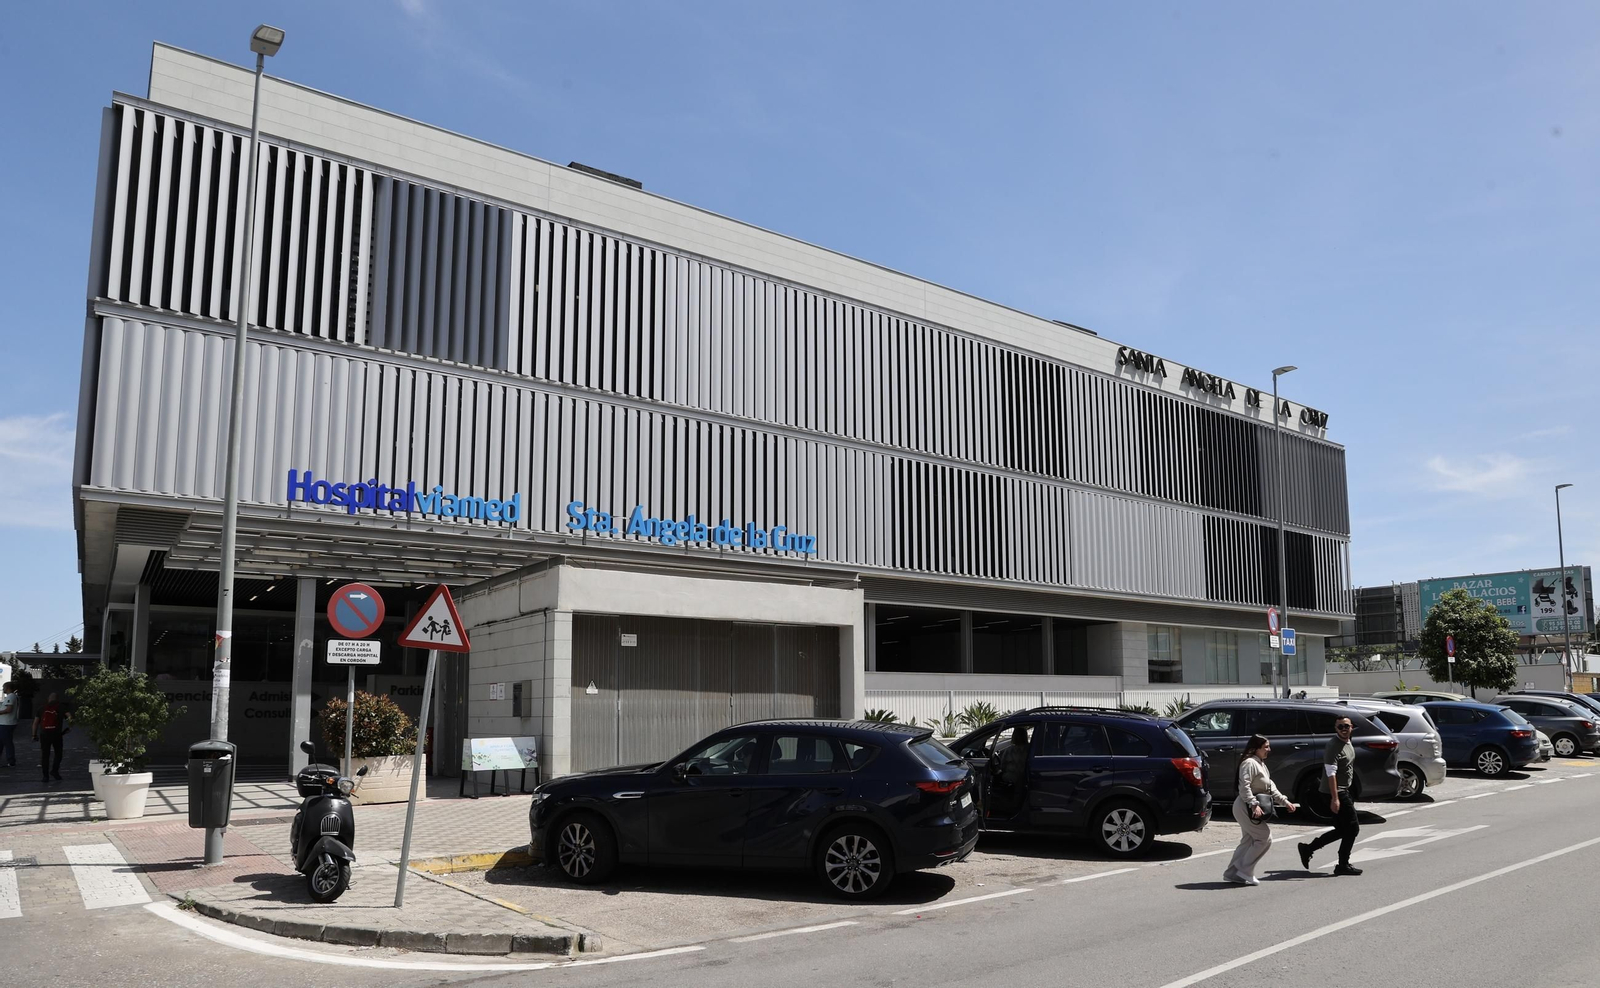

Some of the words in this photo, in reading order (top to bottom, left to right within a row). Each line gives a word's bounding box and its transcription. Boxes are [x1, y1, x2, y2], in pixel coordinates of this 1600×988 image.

[1117, 346, 1168, 378] SANTA
[566, 500, 619, 535] Sta.
[626, 504, 708, 546] Ángela
[712, 518, 742, 547] de
[746, 521, 767, 549] la
[770, 524, 817, 554] Cruz
[1453, 579, 1493, 590] BAZAR
[1466, 586, 1517, 598] ALACIOS
[1496, 596, 1517, 606] BEBÉ
[1282, 637, 1295, 646] TAXI
[166, 690, 213, 703] gencia
[249, 690, 292, 702] Admisi
